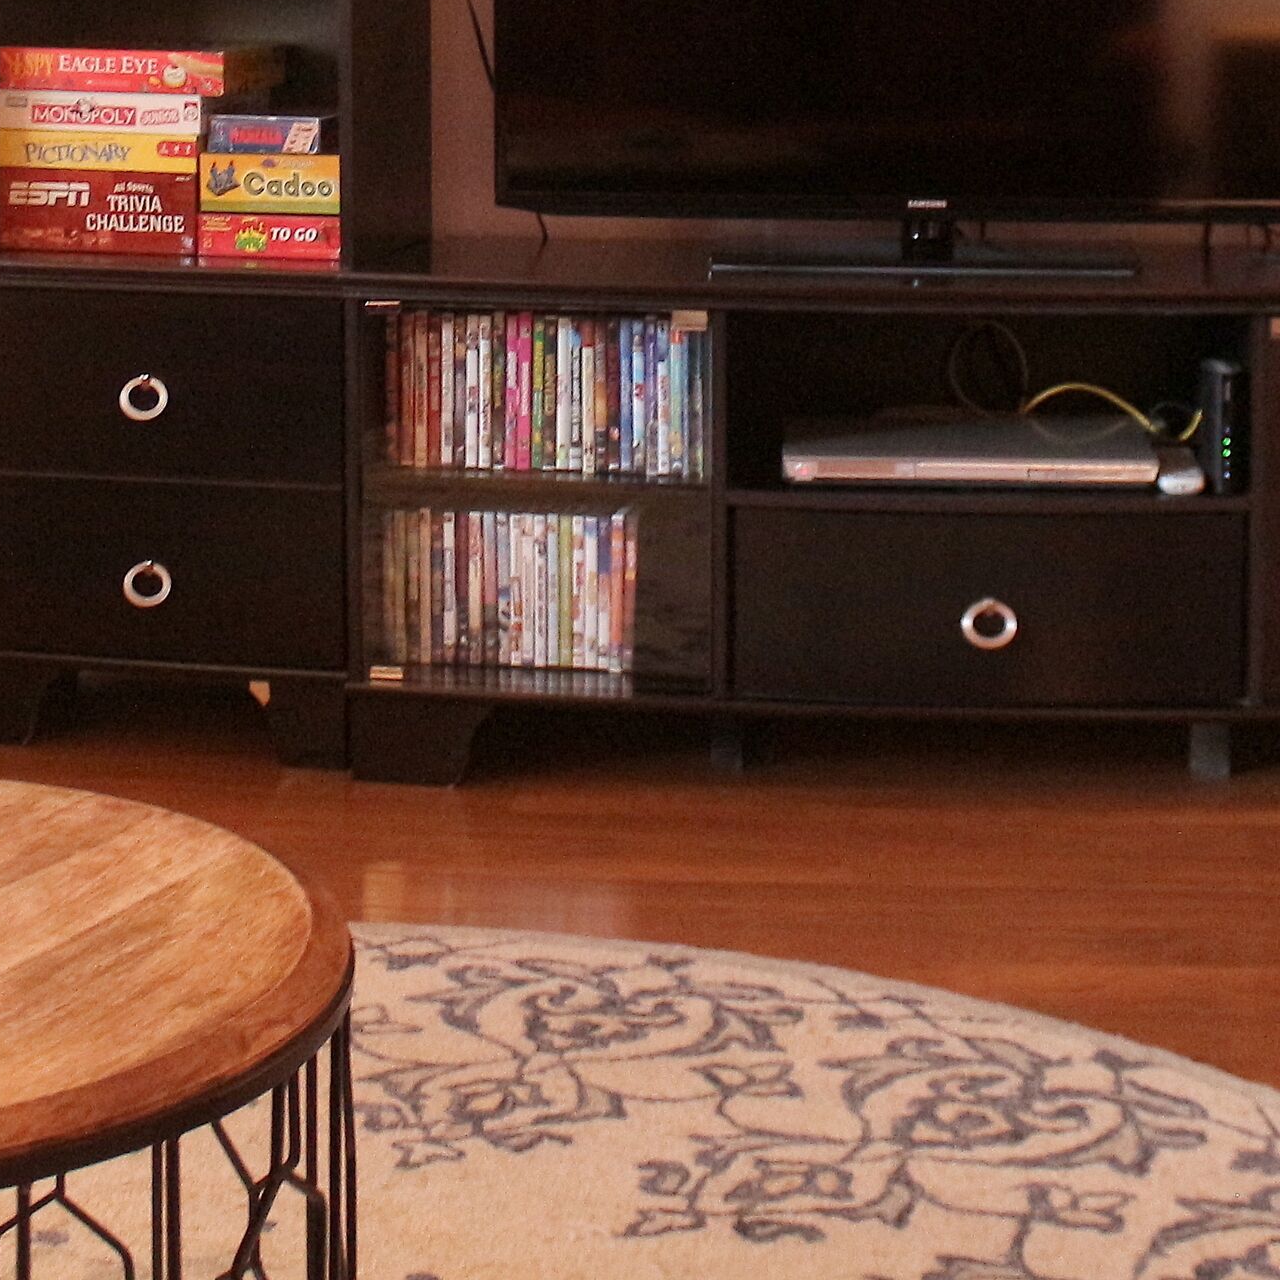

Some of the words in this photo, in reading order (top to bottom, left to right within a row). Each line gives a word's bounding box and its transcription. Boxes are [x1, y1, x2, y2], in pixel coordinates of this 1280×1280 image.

[59, 54, 116, 73] EAGLE
[120, 56, 158, 74] EYE
[33, 106, 135, 125] MONOPOLY
[24, 142, 131, 163] PICTIONARY
[8, 181, 90, 207] ESPN
[243, 171, 333, 197] Cadoo
[106, 194, 163, 213] TRIVIA
[86, 213, 185, 233] CHALLENGE
[270, 227, 291, 242] TO
[294, 228, 318, 242] GO
